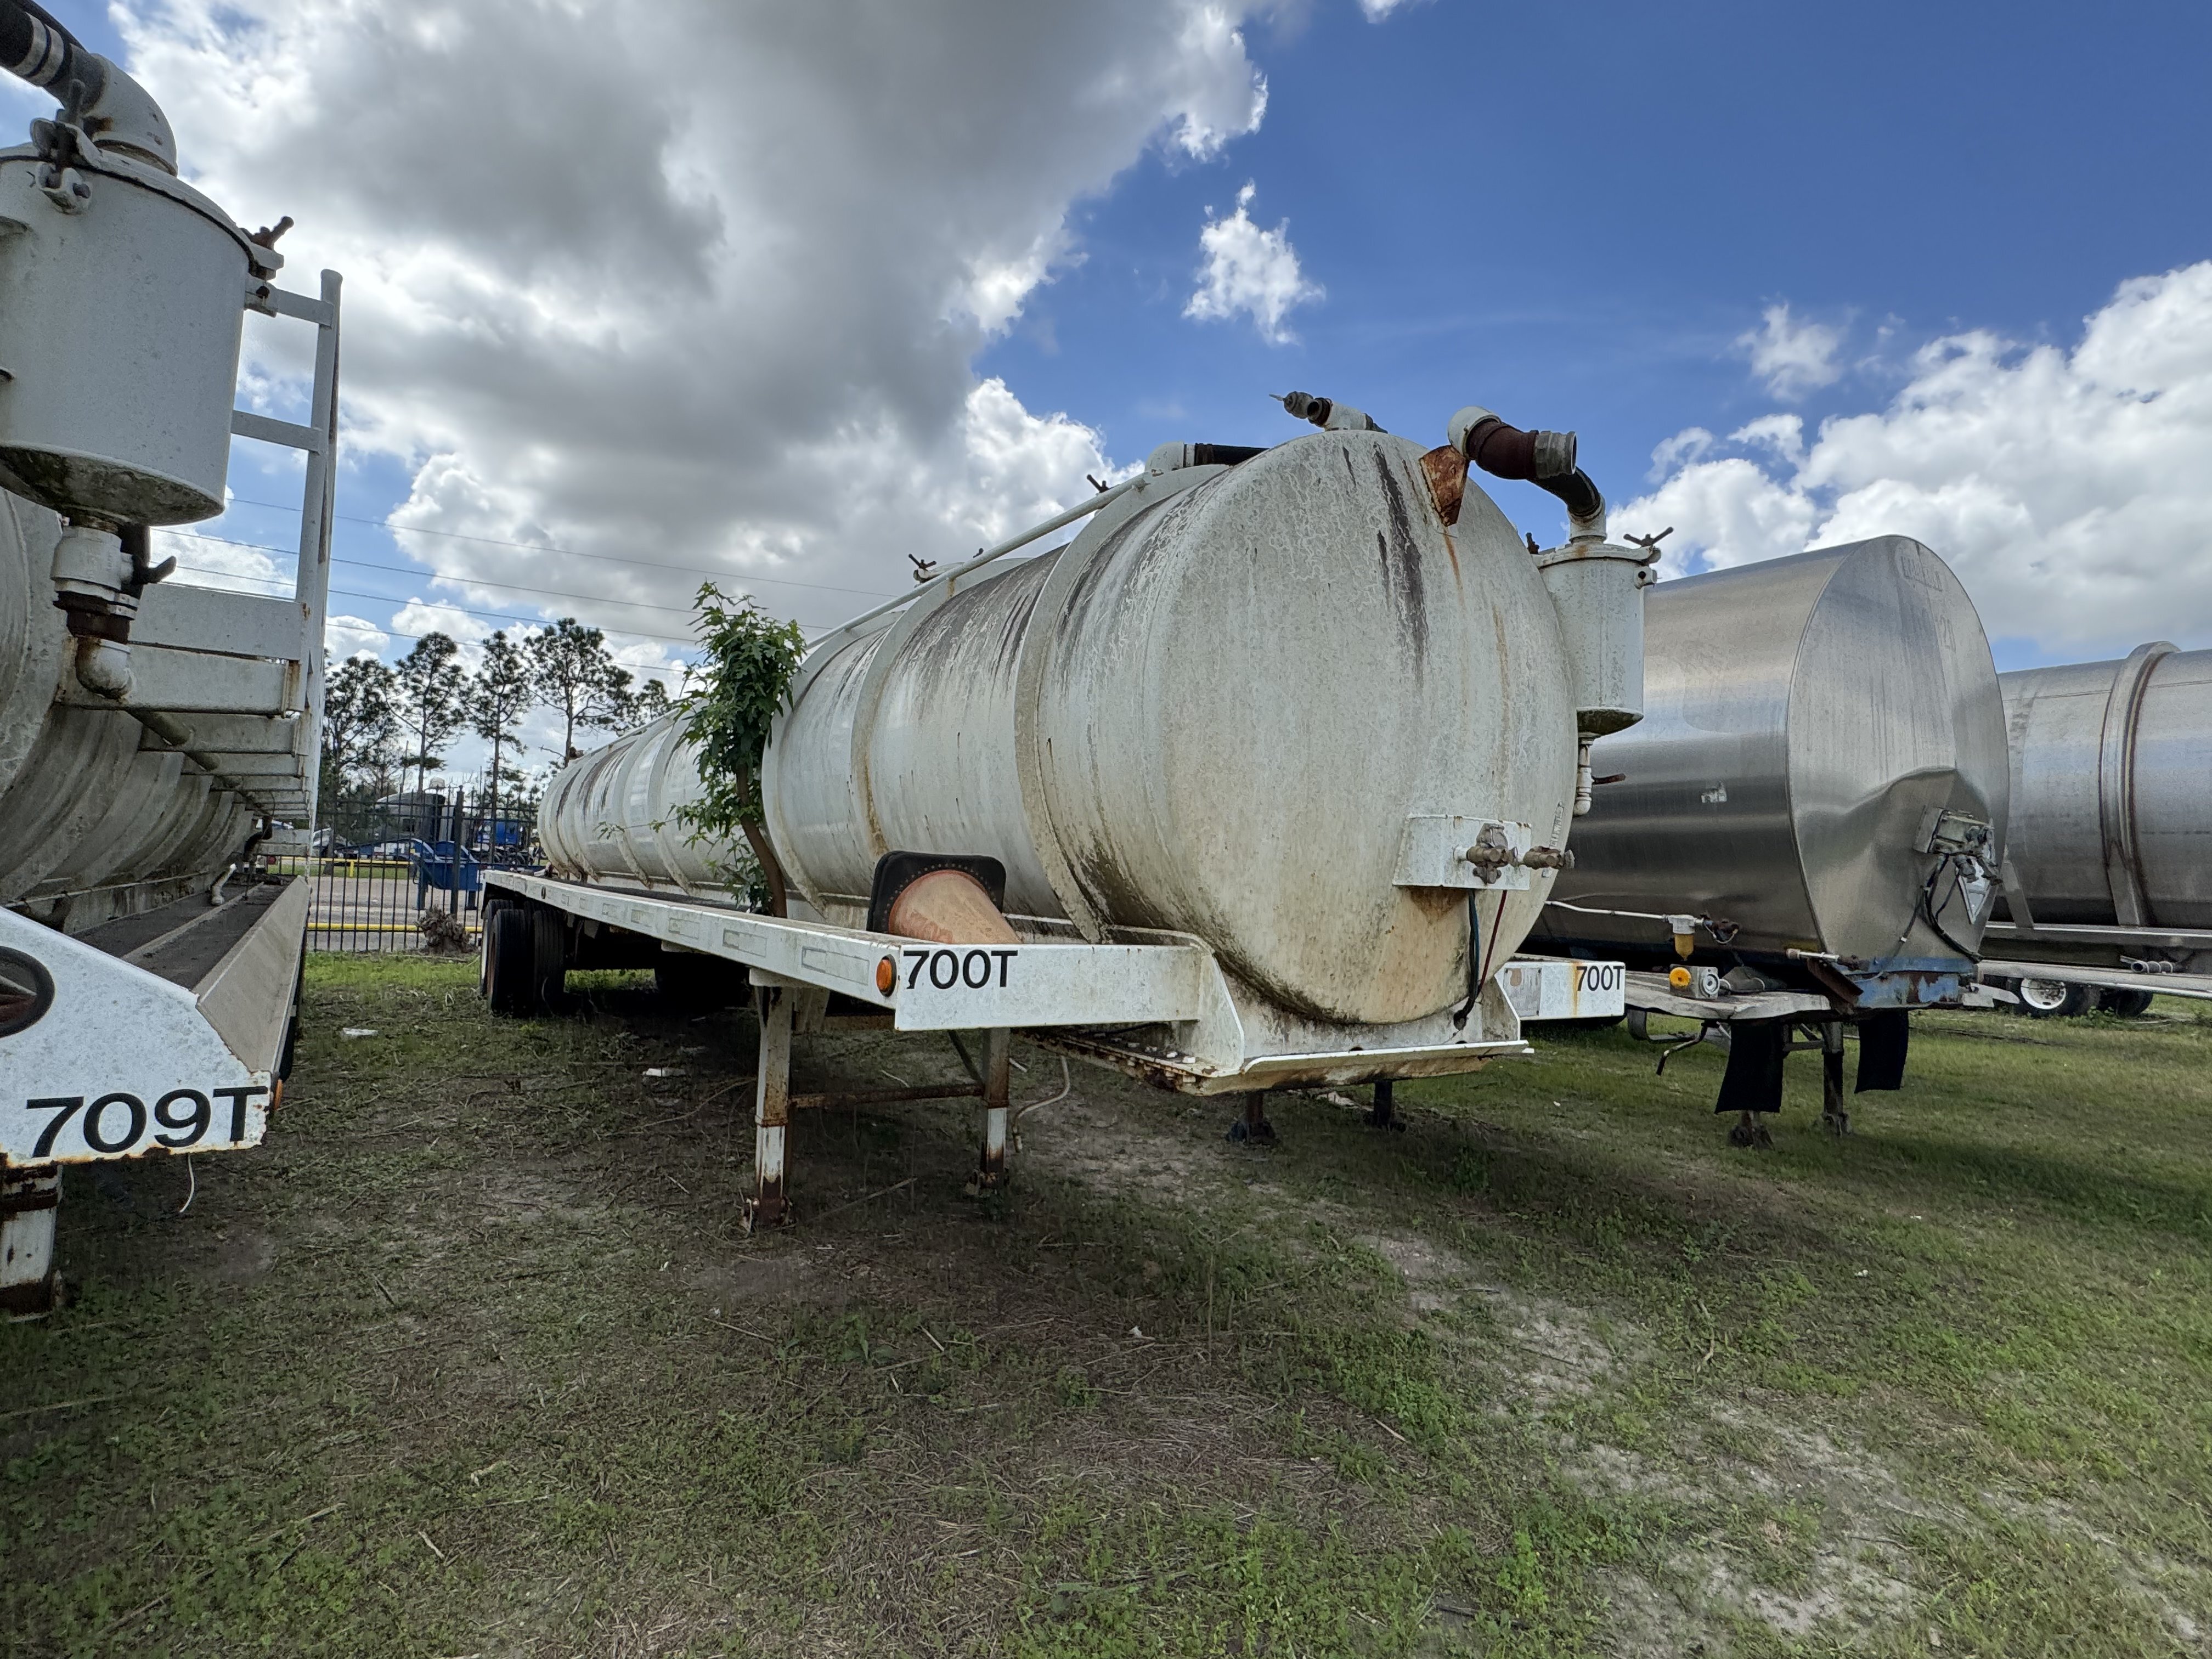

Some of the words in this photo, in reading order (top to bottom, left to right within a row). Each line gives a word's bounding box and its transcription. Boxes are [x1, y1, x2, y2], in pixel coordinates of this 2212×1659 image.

[903, 949, 1018, 989] 700T
[1576, 965, 1624, 991] 700T
[26, 1086, 268, 1158] 709T
